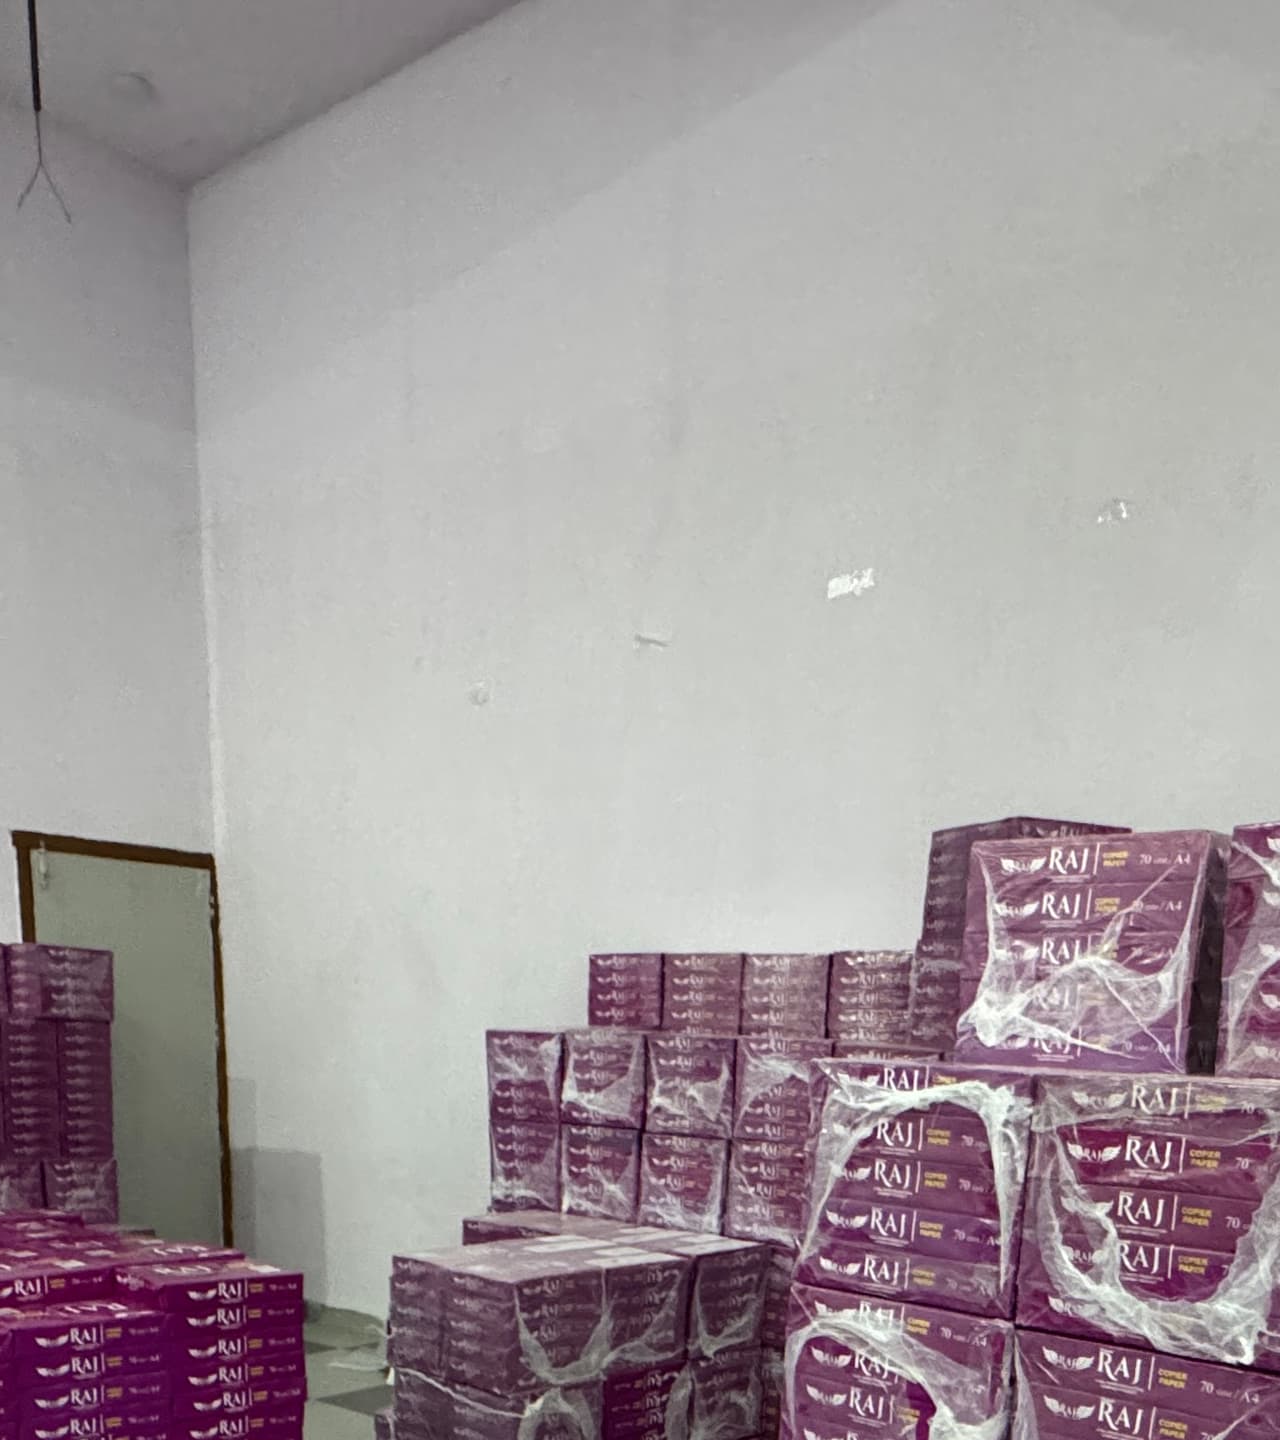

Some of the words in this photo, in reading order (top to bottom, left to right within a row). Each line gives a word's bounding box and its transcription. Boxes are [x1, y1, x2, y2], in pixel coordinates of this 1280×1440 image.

[1049, 848, 1089, 873] RAJ
[1042, 893, 1081, 918] RAJ
[876, 1119, 913, 1146] RAJ
[1125, 1139, 1172, 1169] RAJ
[1190, 1150, 1221, 1159] COPIER
[1191, 1159, 1219, 1168] PAPER
[1235, 1158, 1249, 1169] 70
[875, 1162, 910, 1188] RAJ
[1117, 1195, 1164, 1226] RAJ
[1182, 1207, 1212, 1217] COPIER
[1182, 1216, 1209, 1226] PAPER
[871, 1210, 906, 1237] RAJ
[1225, 1217, 1240, 1228] 70
[218, 1284, 242, 1297] RAJ
[70, 1328, 98, 1344] RAJ
[220, 1368, 243, 1382] RAJ
[1098, 1350, 1143, 1383] RAJ
[71, 1387, 98, 1404] RAJ
[1200, 1381, 1214, 1393] 70
[1241, 1391, 1259, 1403] A4
[850, 1391, 883, 1418] RAJ
[1098, 1400, 1143, 1433] RAJ
